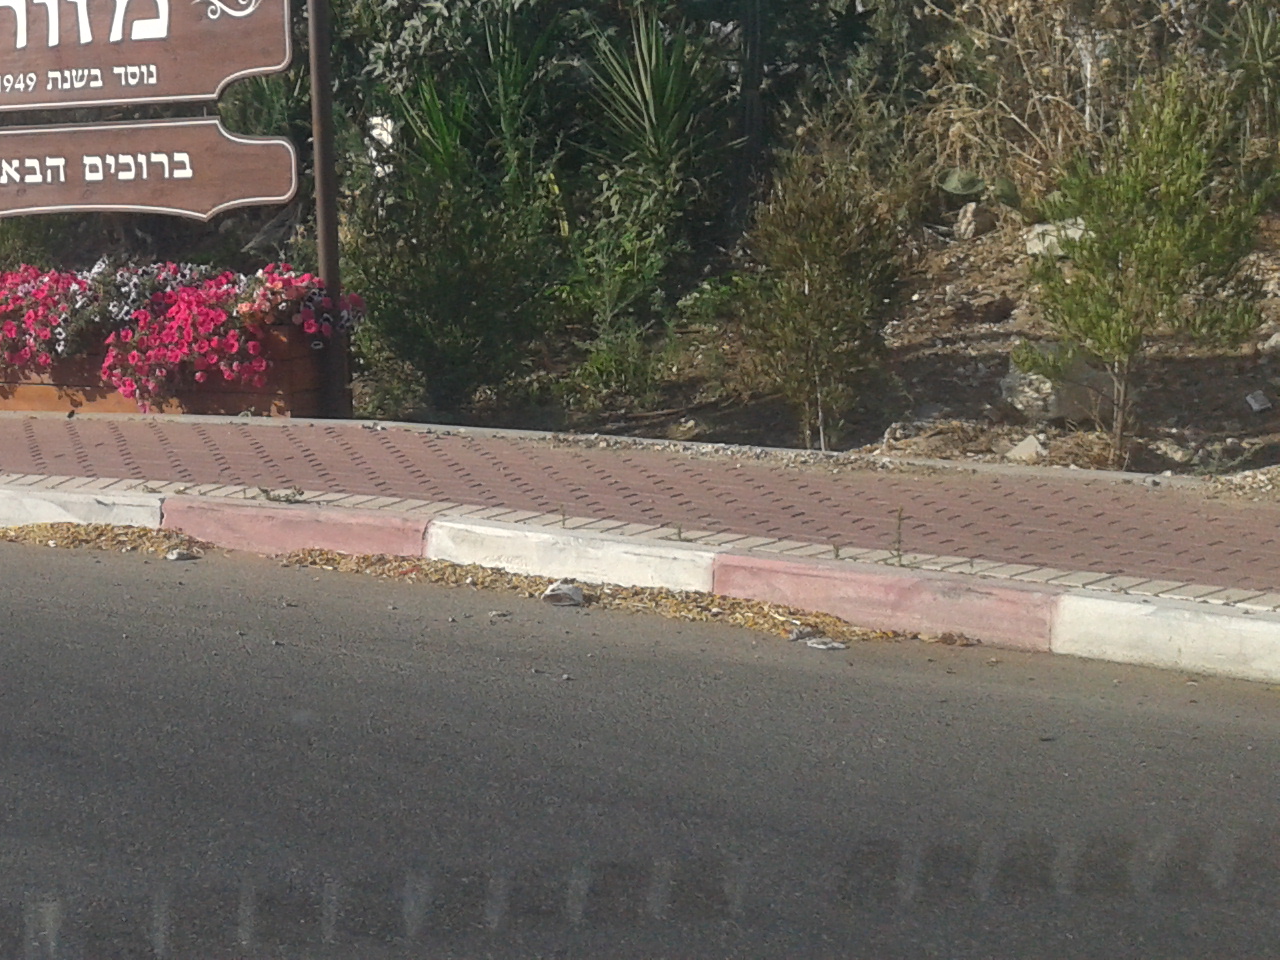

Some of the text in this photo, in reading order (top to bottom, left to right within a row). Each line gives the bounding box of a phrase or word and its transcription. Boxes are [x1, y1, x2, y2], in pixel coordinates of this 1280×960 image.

[46, 68, 103, 90] בשנת
[112, 64, 157, 86] נוסד
[83, 152, 193, 181] ברוכים
